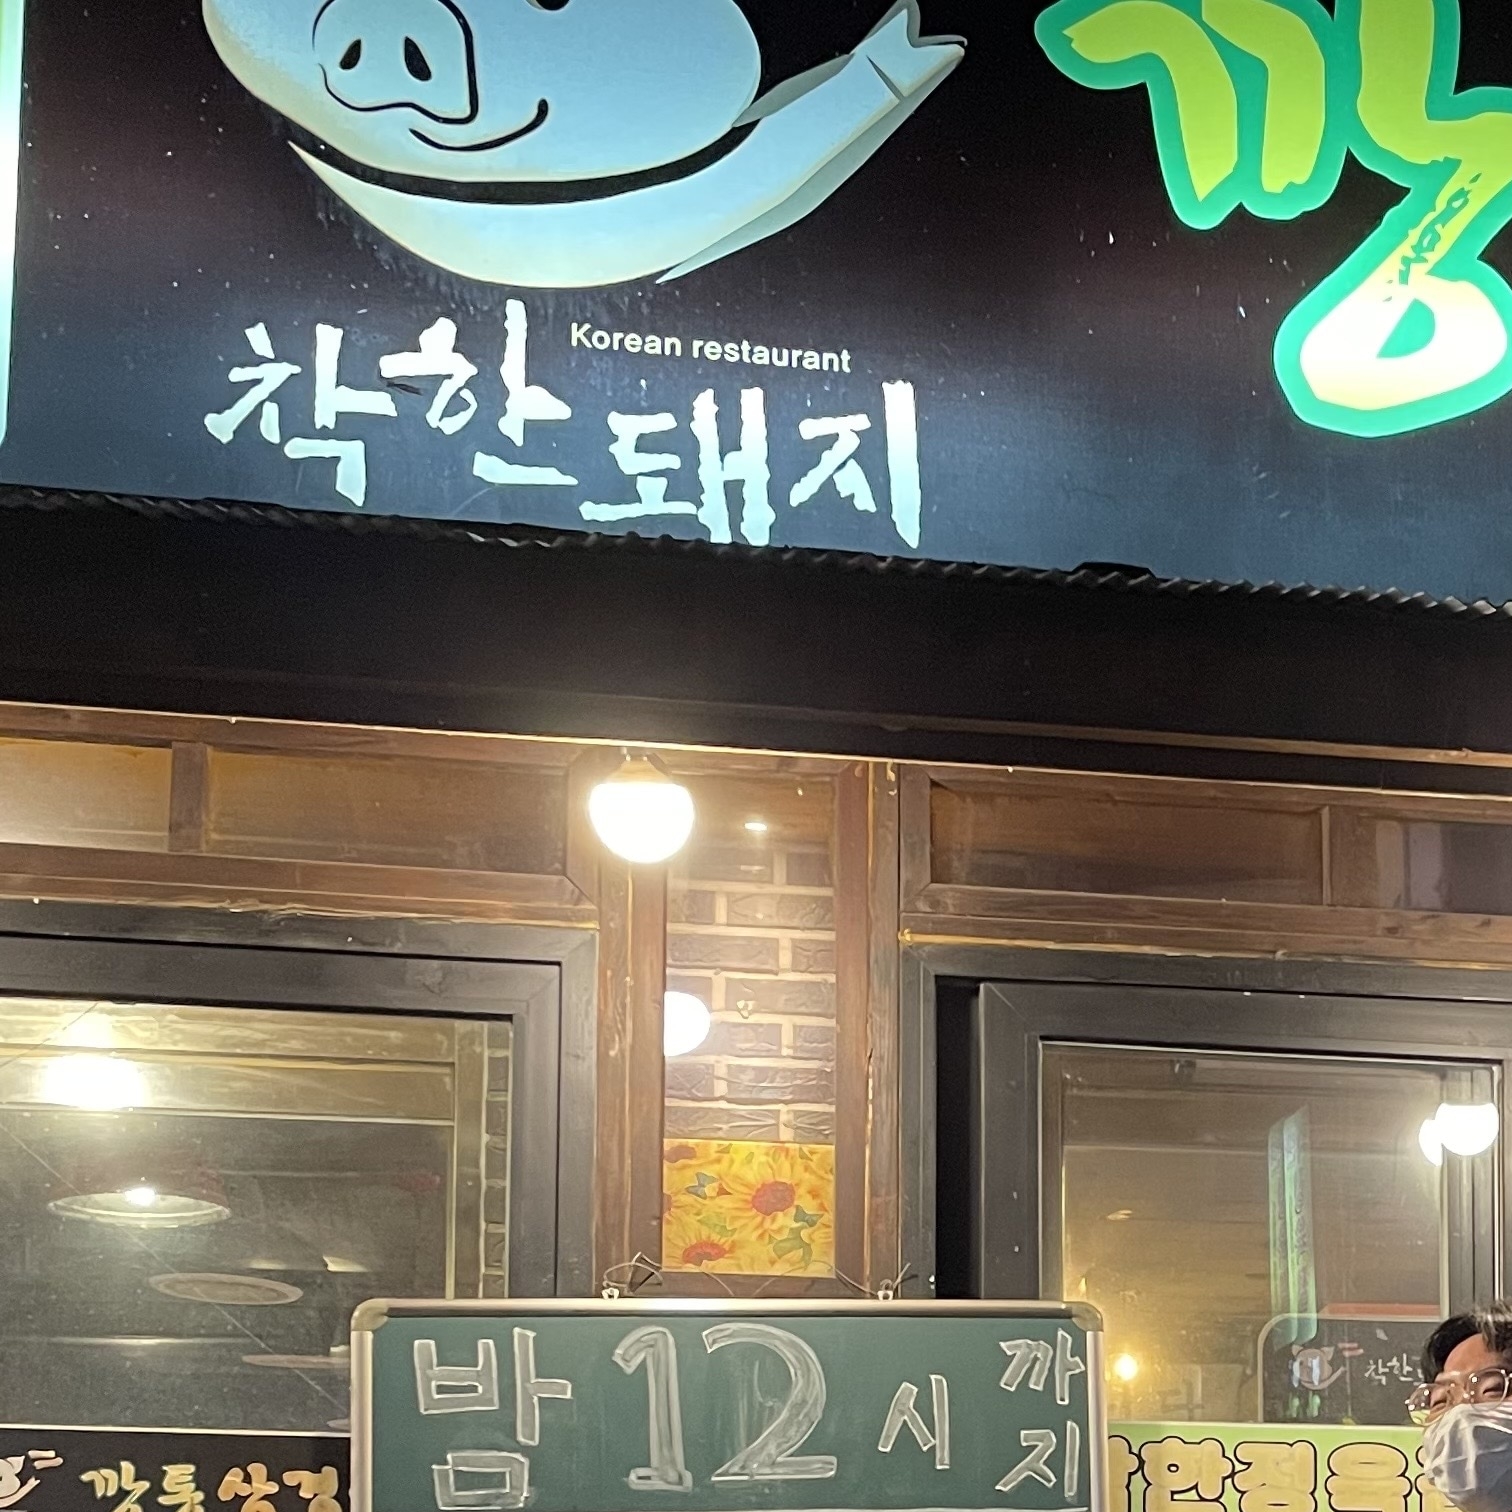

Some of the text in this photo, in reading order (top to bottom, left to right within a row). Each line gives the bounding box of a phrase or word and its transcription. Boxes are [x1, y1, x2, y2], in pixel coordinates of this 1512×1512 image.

[204, 298, 922, 549] 착한돼지
[570, 322, 852, 374] Korean restaurant
[413, 1326, 572, 1511] 밤
